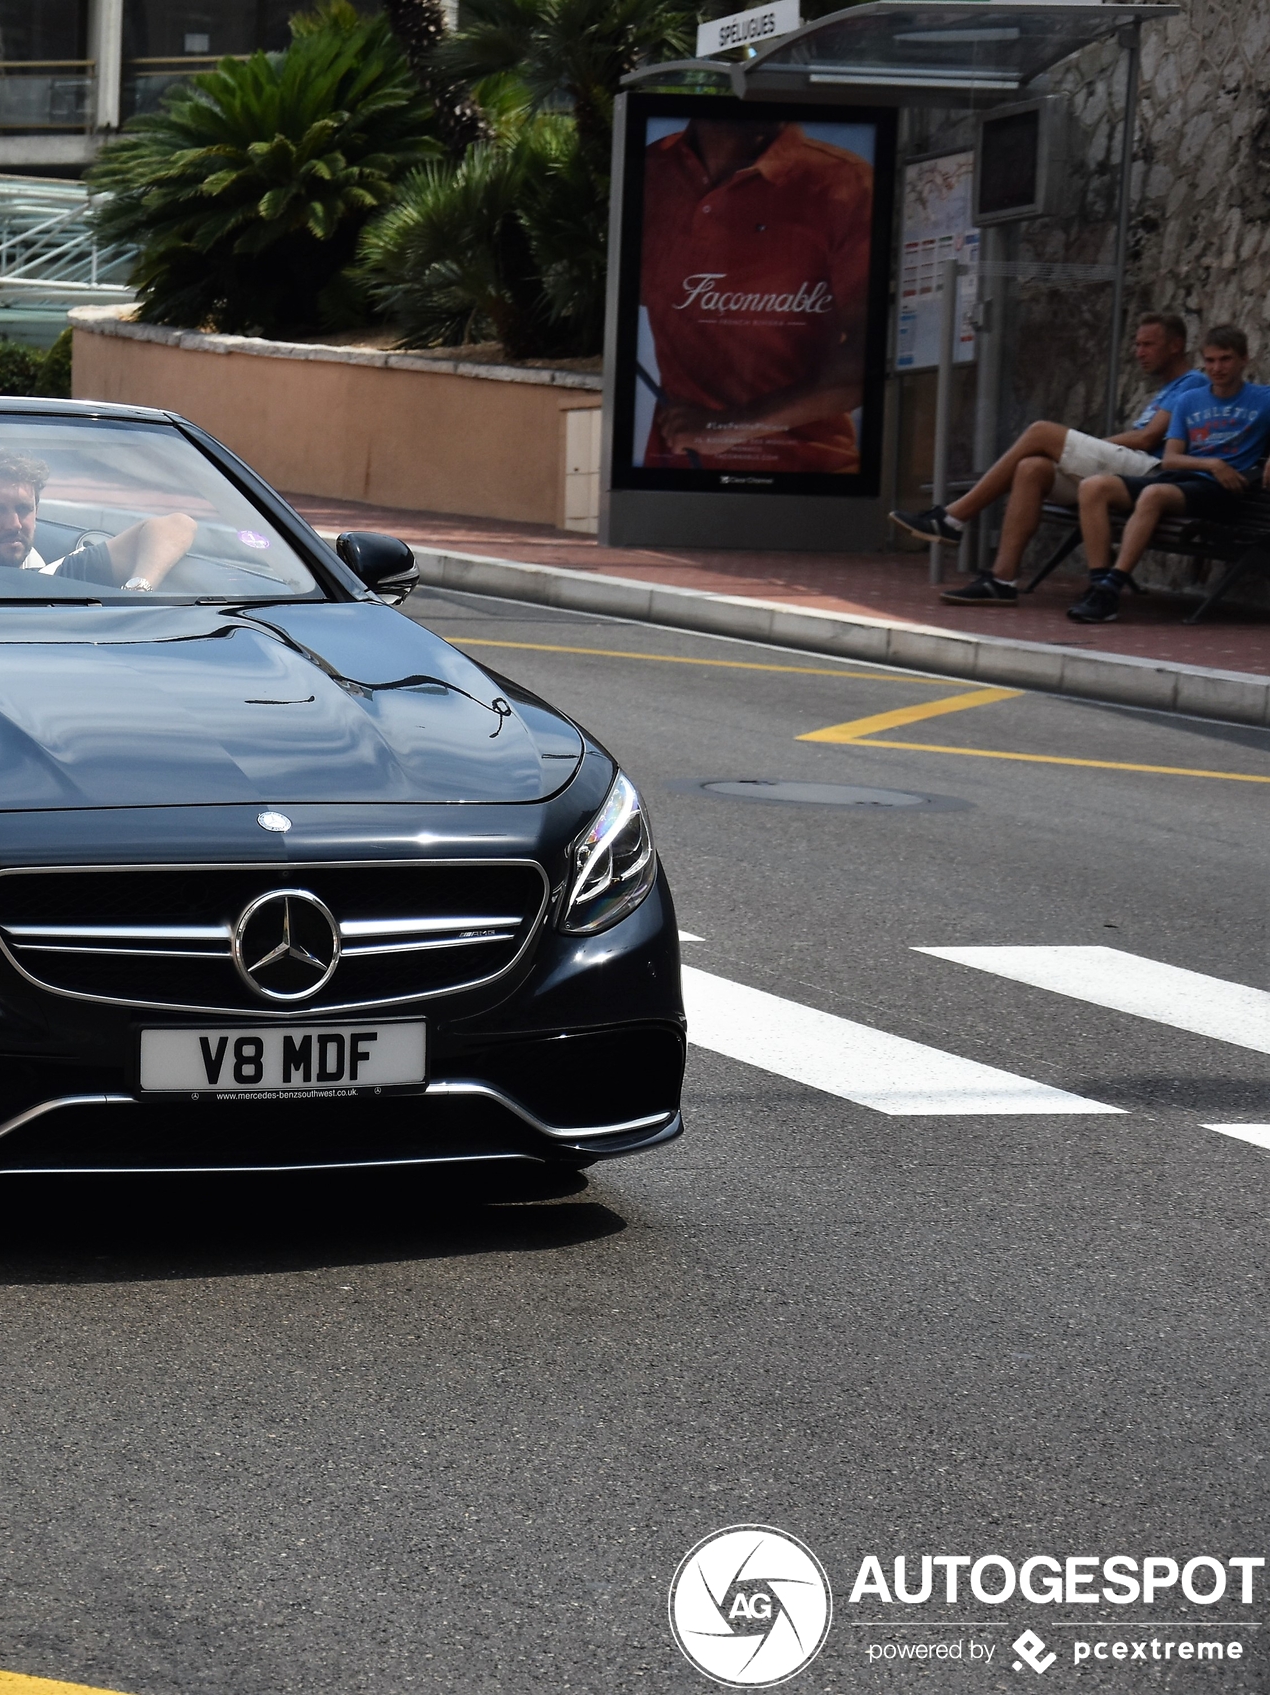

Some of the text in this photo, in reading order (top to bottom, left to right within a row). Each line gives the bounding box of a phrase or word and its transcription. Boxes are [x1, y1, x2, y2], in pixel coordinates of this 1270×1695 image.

[672, 273, 833, 316] Façonnable
[199, 1032, 378, 1085] V8 MDF
